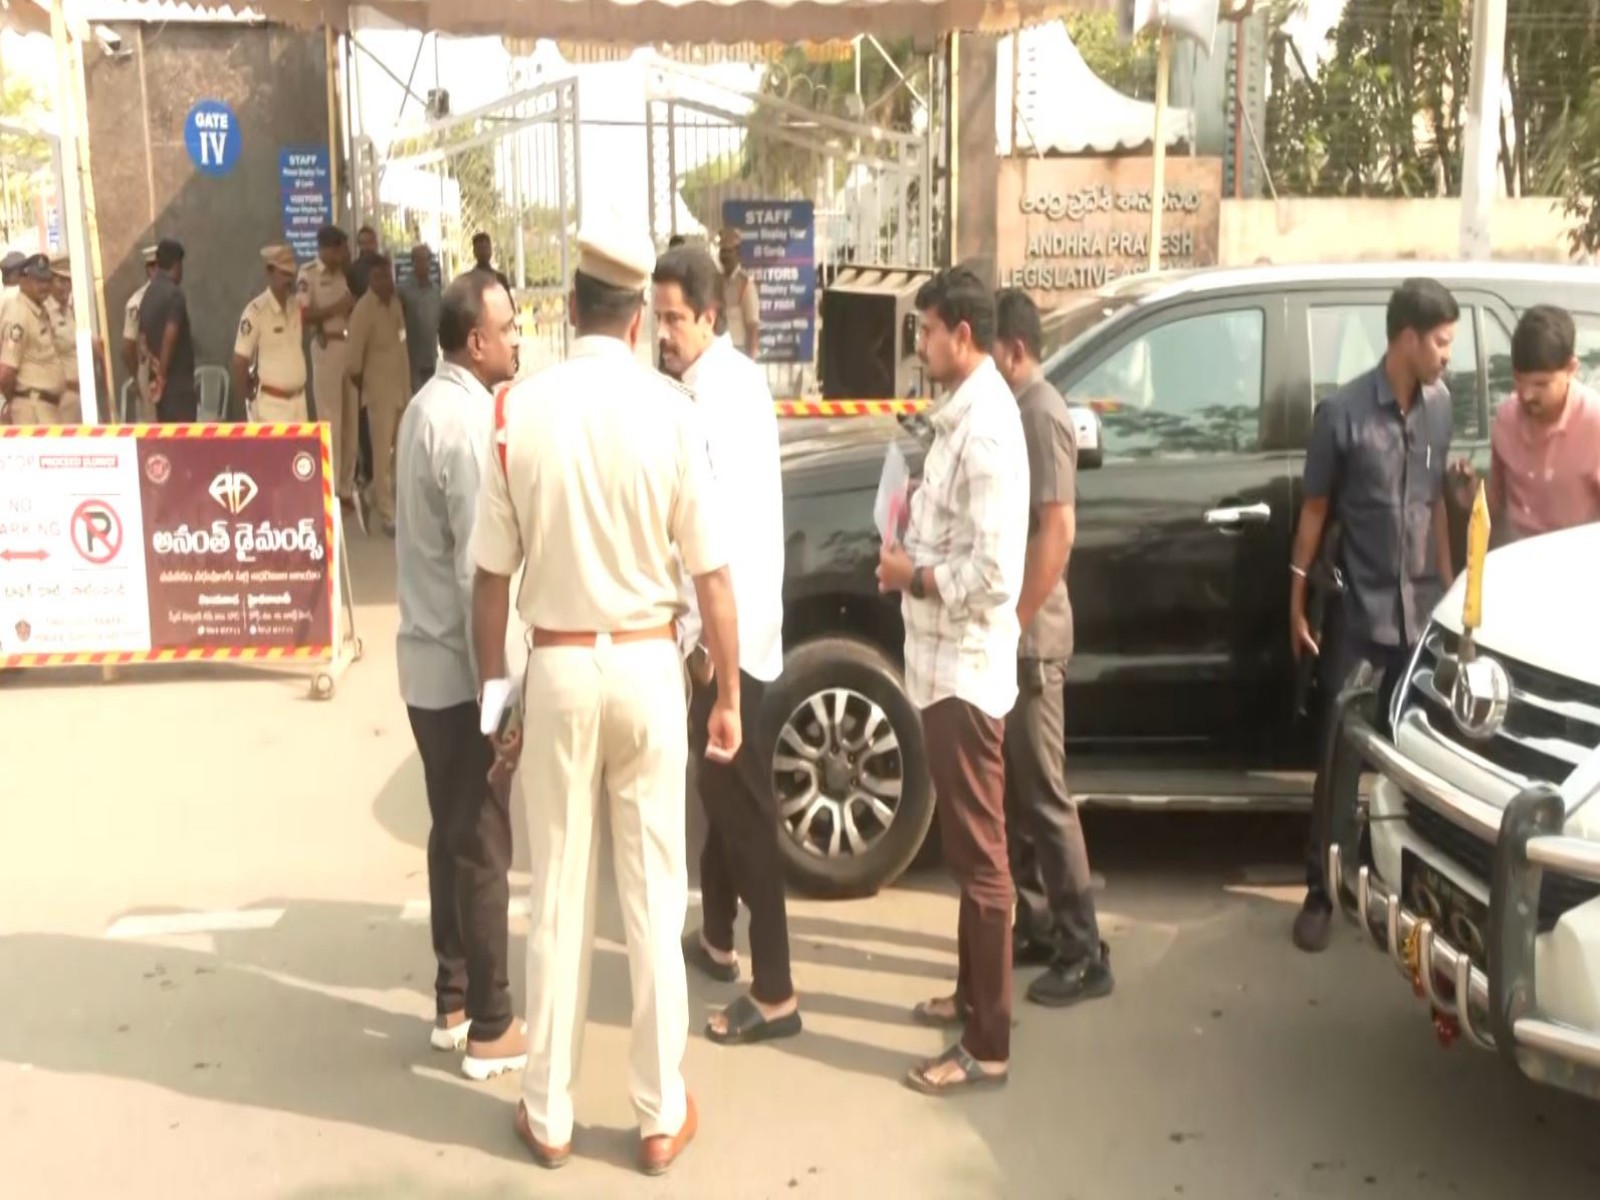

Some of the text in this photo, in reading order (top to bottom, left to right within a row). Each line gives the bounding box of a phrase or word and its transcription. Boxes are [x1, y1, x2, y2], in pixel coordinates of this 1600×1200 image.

[195, 112, 229, 129] GATE
[199, 131, 226, 165] IV
[289, 155, 317, 166] STAFF
[745, 210, 792, 224] STAFF
[1029, 231, 1194, 257] ANDHRA PRAESH
[1001, 262, 1117, 289] LEGISLATIVE
[8, 497, 32, 513] NO
